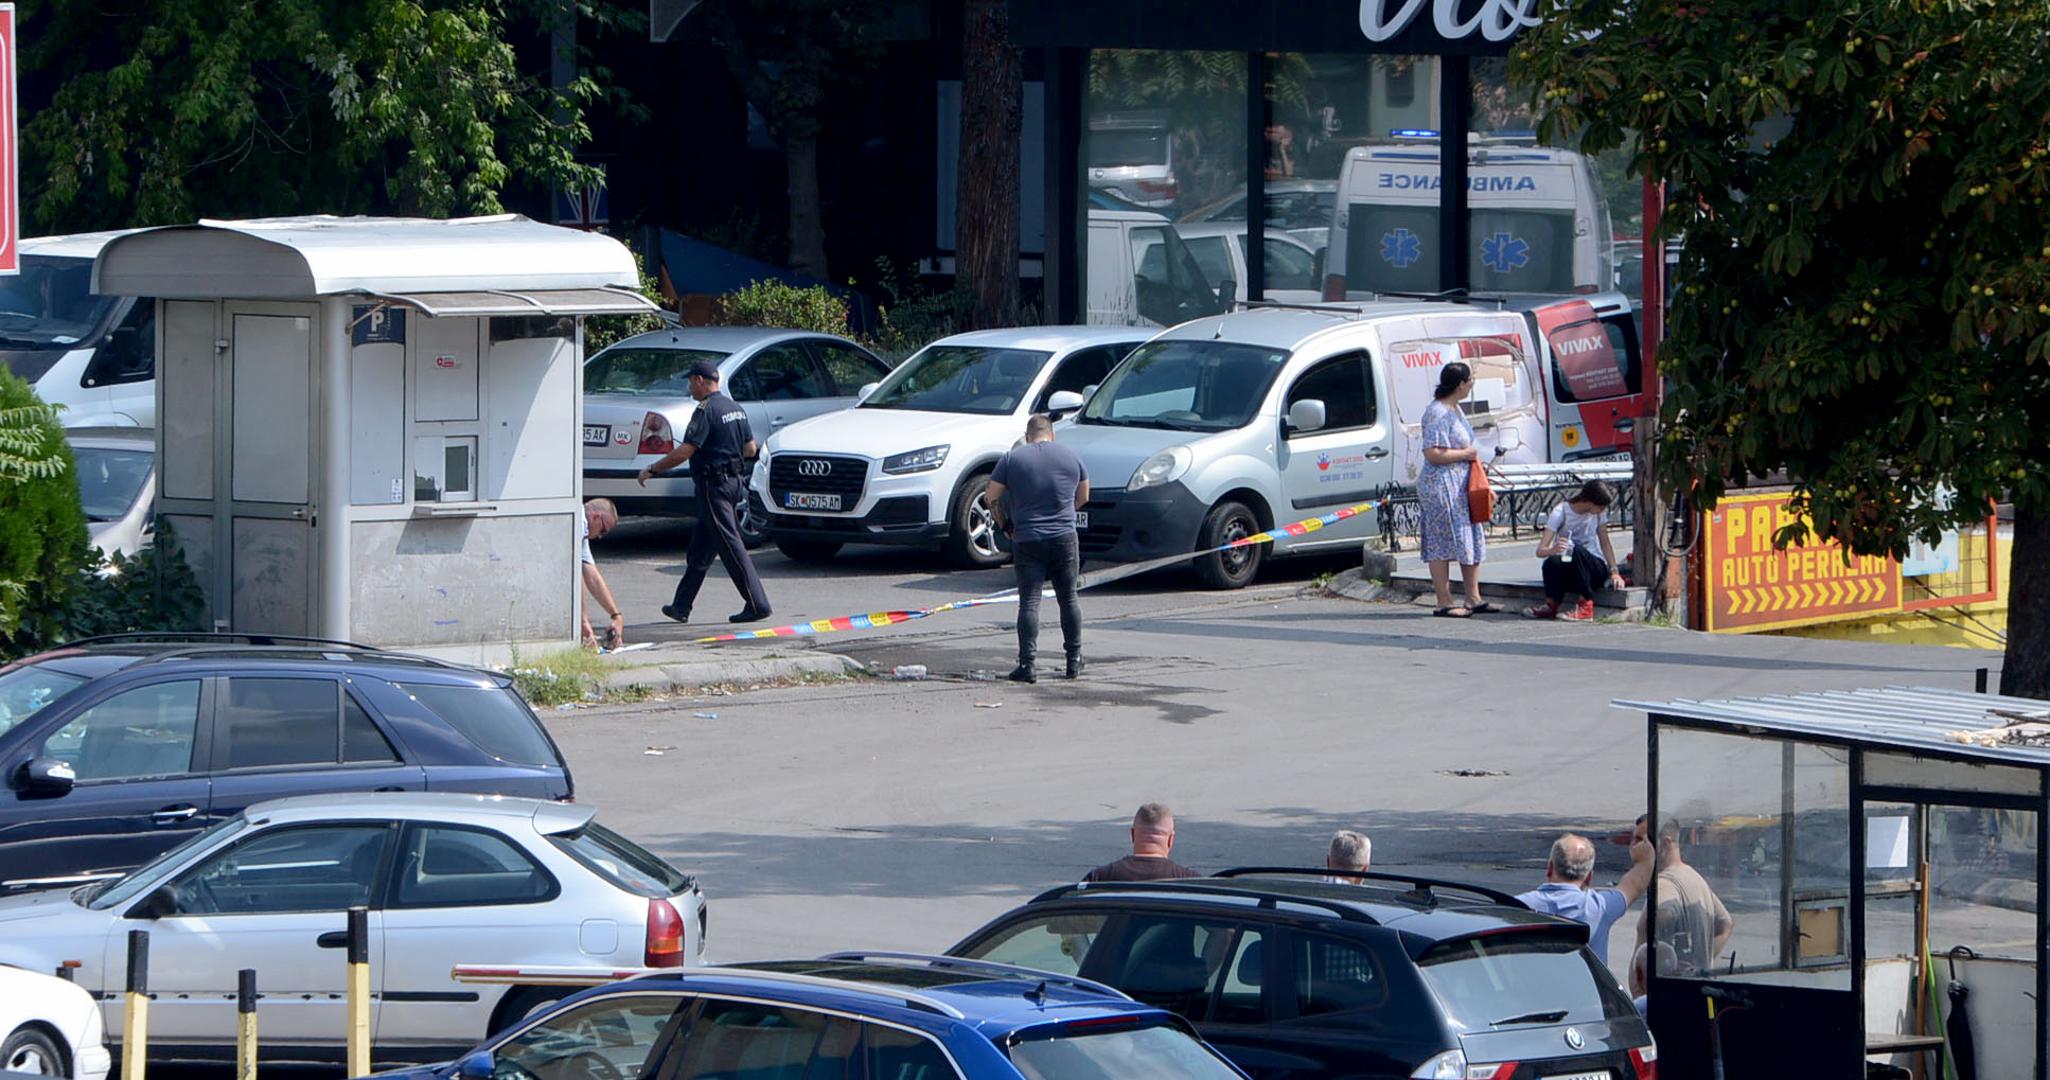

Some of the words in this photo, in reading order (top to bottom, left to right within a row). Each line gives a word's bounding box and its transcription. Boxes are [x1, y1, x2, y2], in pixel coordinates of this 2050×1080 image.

[1557, 335, 1604, 356] VIVAX
[1401, 351, 1443, 368] VIVAX
[592, 428, 605, 441] AK
[790, 494, 800, 508] SK
[1722, 555, 1779, 588] AUTO
